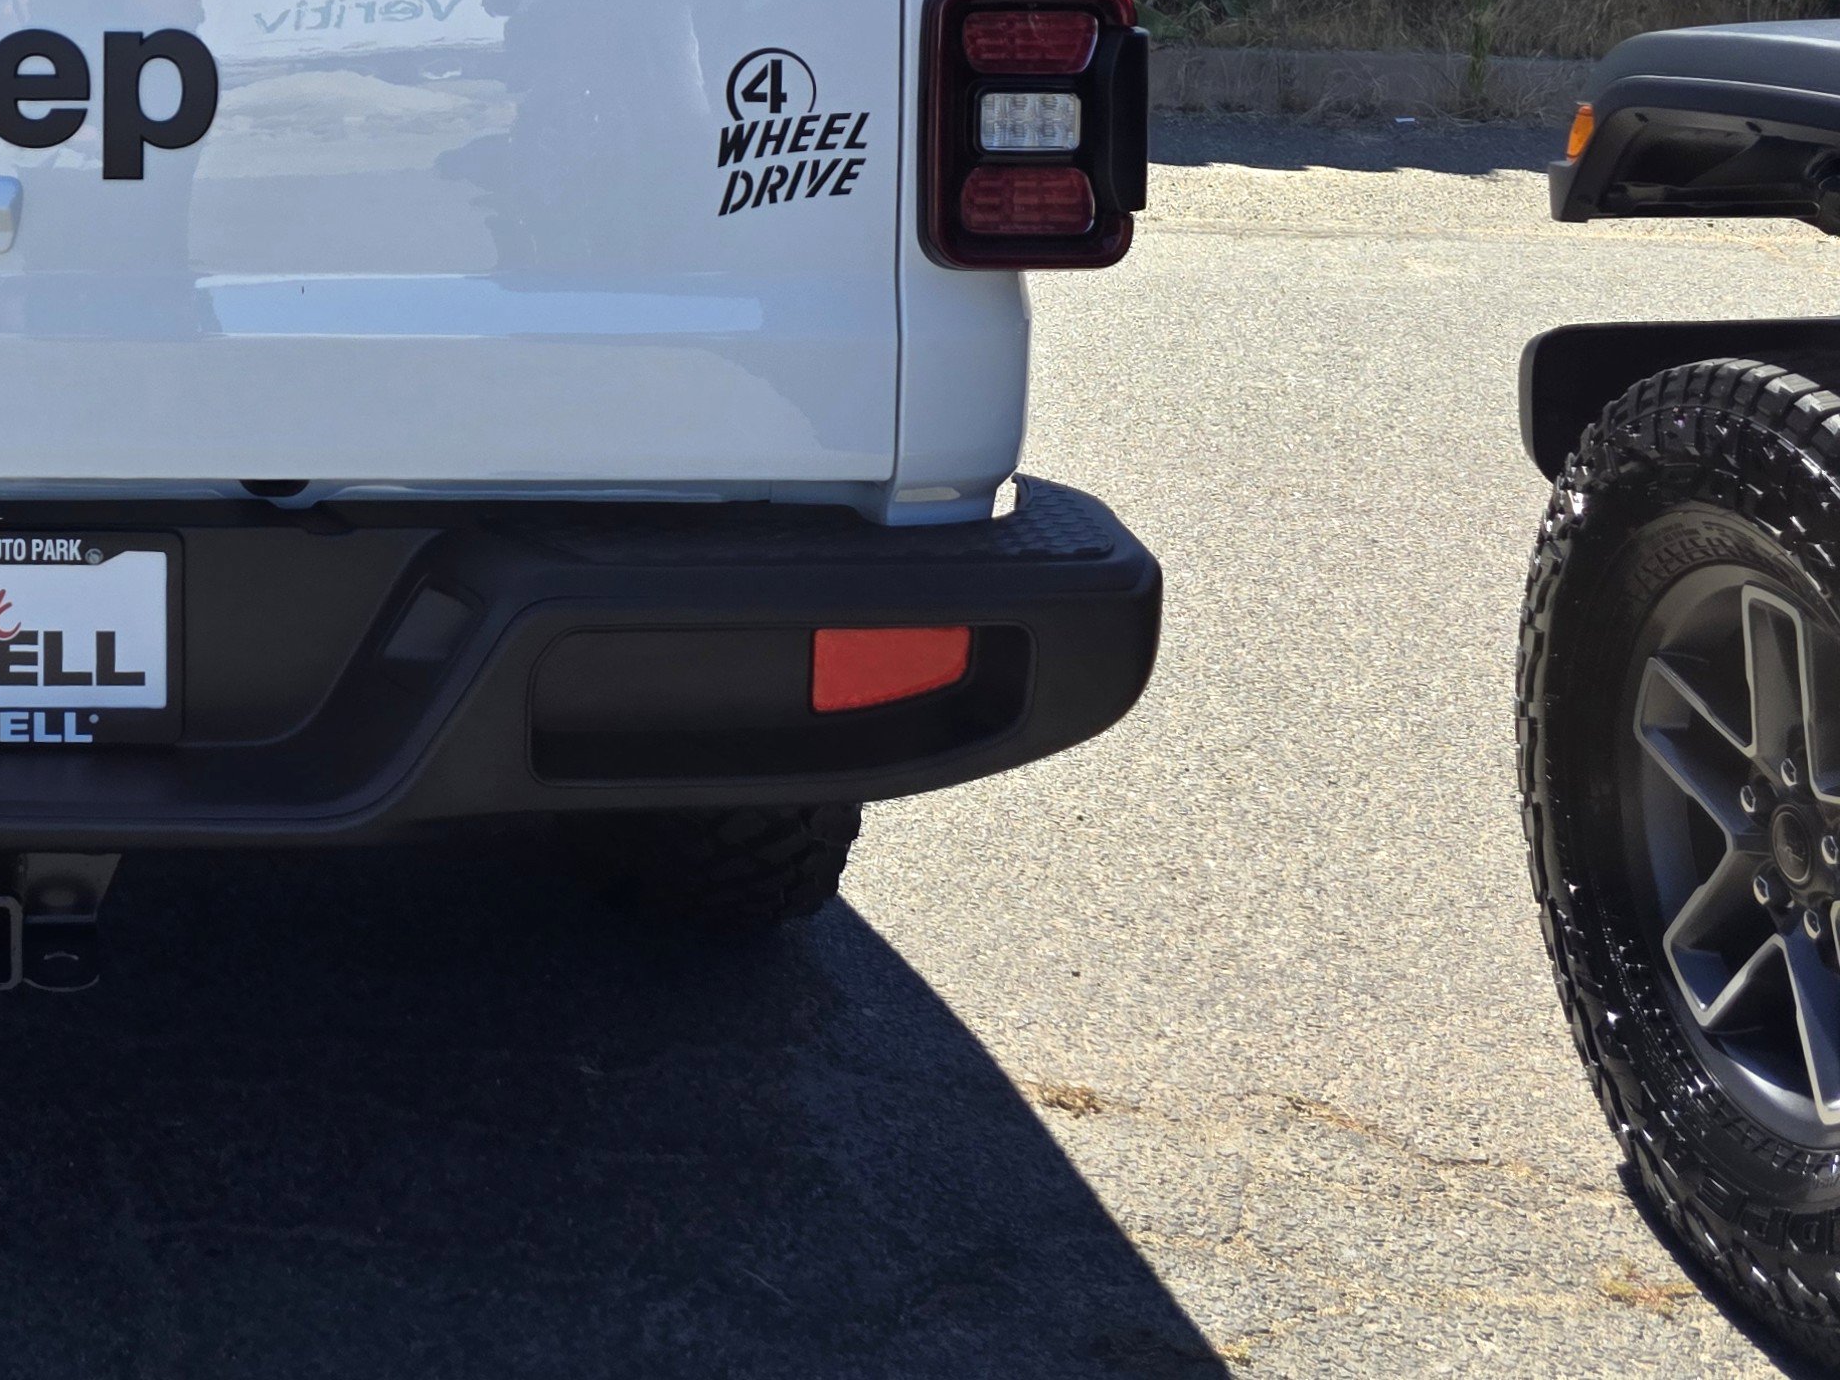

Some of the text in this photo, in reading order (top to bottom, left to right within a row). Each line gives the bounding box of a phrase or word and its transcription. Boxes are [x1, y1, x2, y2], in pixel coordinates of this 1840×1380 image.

[740, 58, 788, 114] 4
[717, 111, 871, 168] WHEEL
[717, 157, 867, 217] DRIVE
[31, 538, 82, 561] PARK
